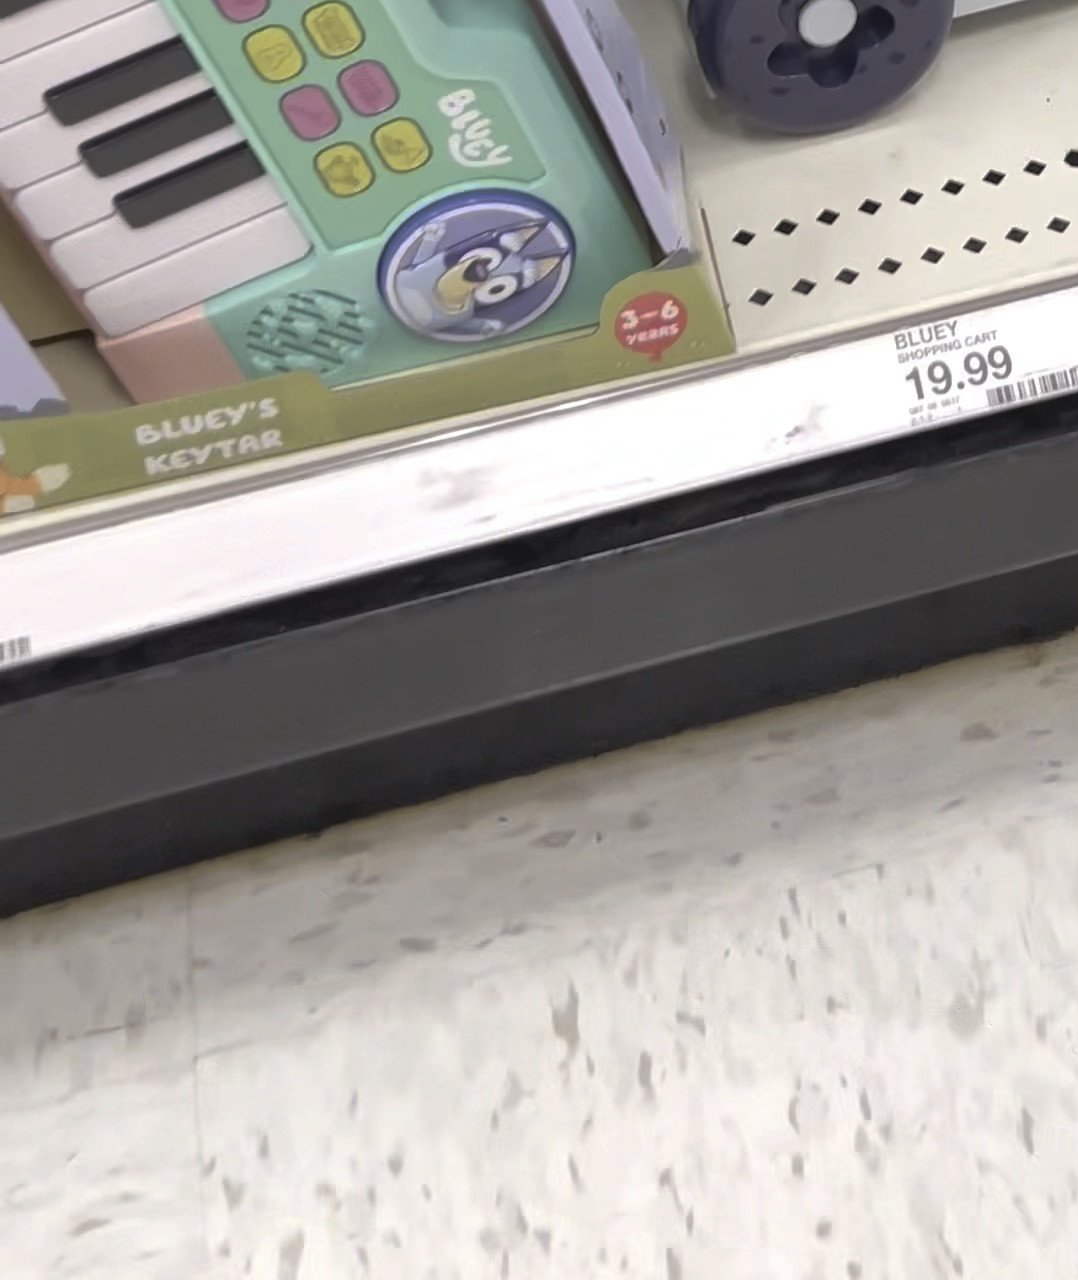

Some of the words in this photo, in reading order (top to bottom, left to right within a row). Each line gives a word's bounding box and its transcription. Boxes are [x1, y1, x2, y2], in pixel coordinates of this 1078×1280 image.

[438, 89, 513, 168] BLUEY
[625, 322, 680, 345] YEARS
[894, 320, 959, 351] BLUEY
[897, 339, 962, 364] SHOPPING
[964, 330, 998, 348] CART
[905, 345, 1014, 400] 19.99
[135, 397, 280, 446] BLUEY'S
[143, 429, 285, 475] KEYTAR
